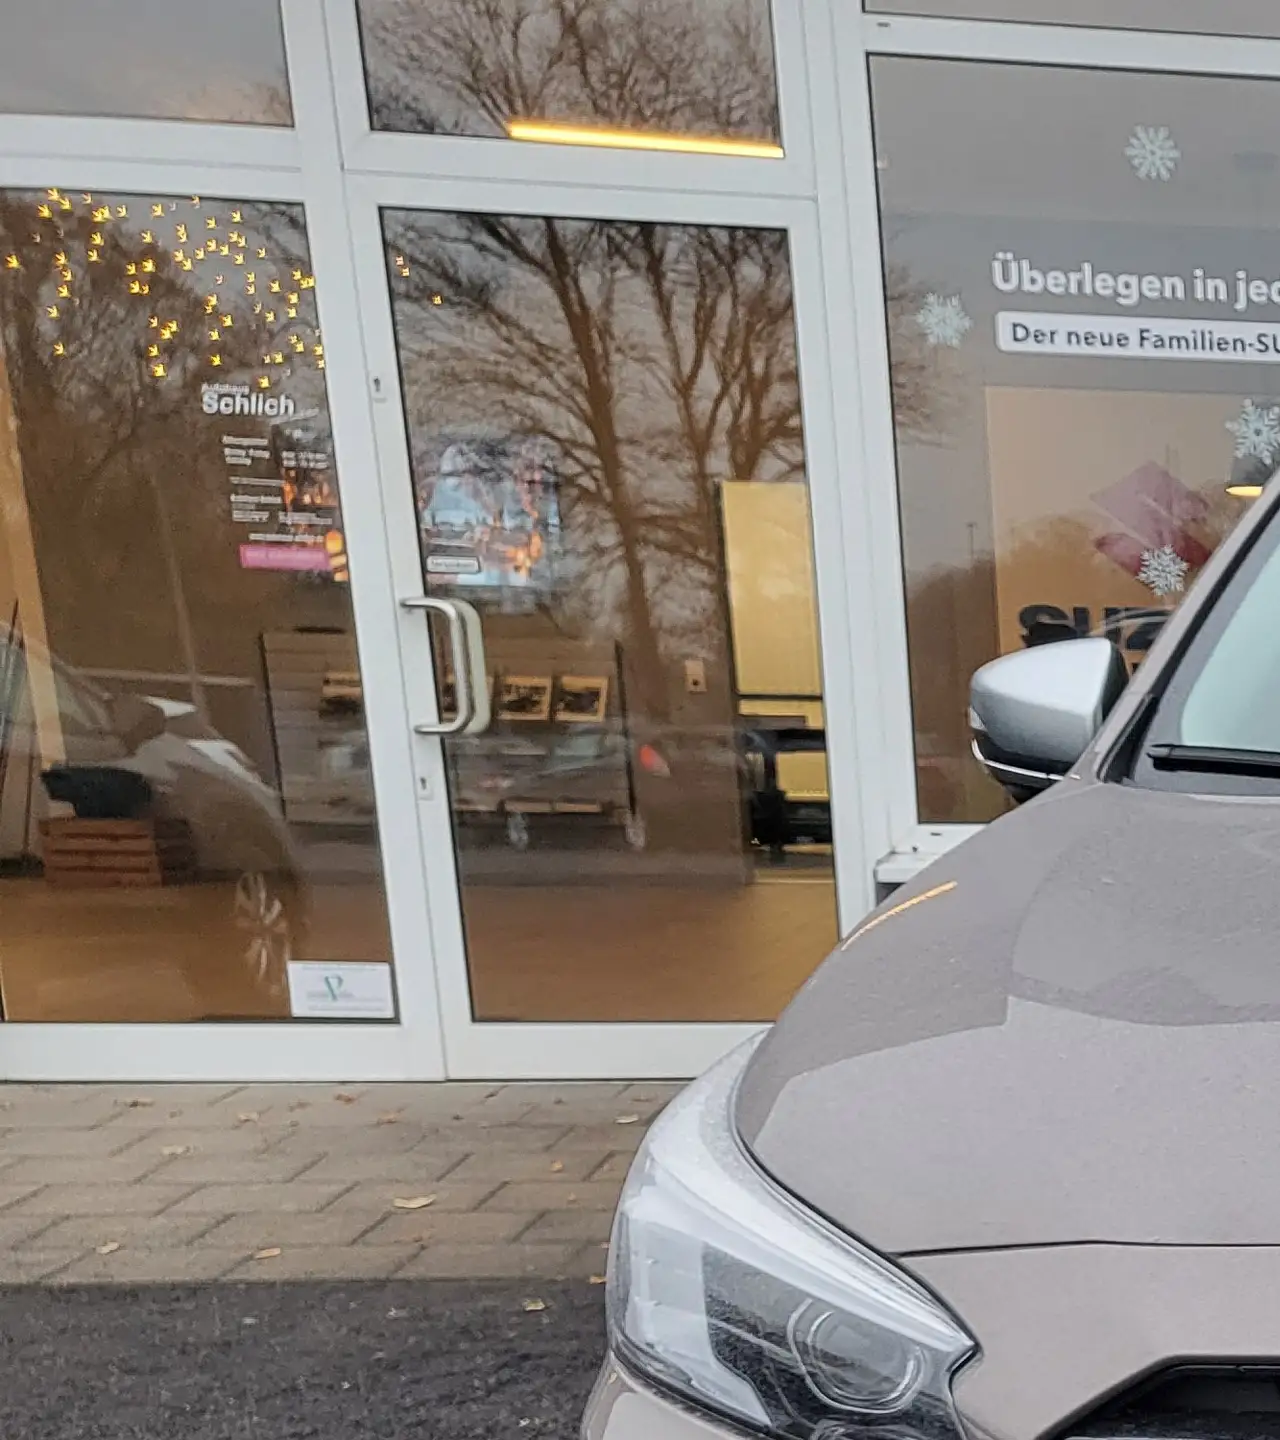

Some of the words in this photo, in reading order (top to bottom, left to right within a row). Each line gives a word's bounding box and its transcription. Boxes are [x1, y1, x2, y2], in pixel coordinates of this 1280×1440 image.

[992, 252, 1186, 306] Überlegen
[1193, 268, 1228, 303] in
[1012, 322, 1059, 345] Der
[1067, 329, 1130, 348] neue
[202, 392, 294, 416] Schlich
